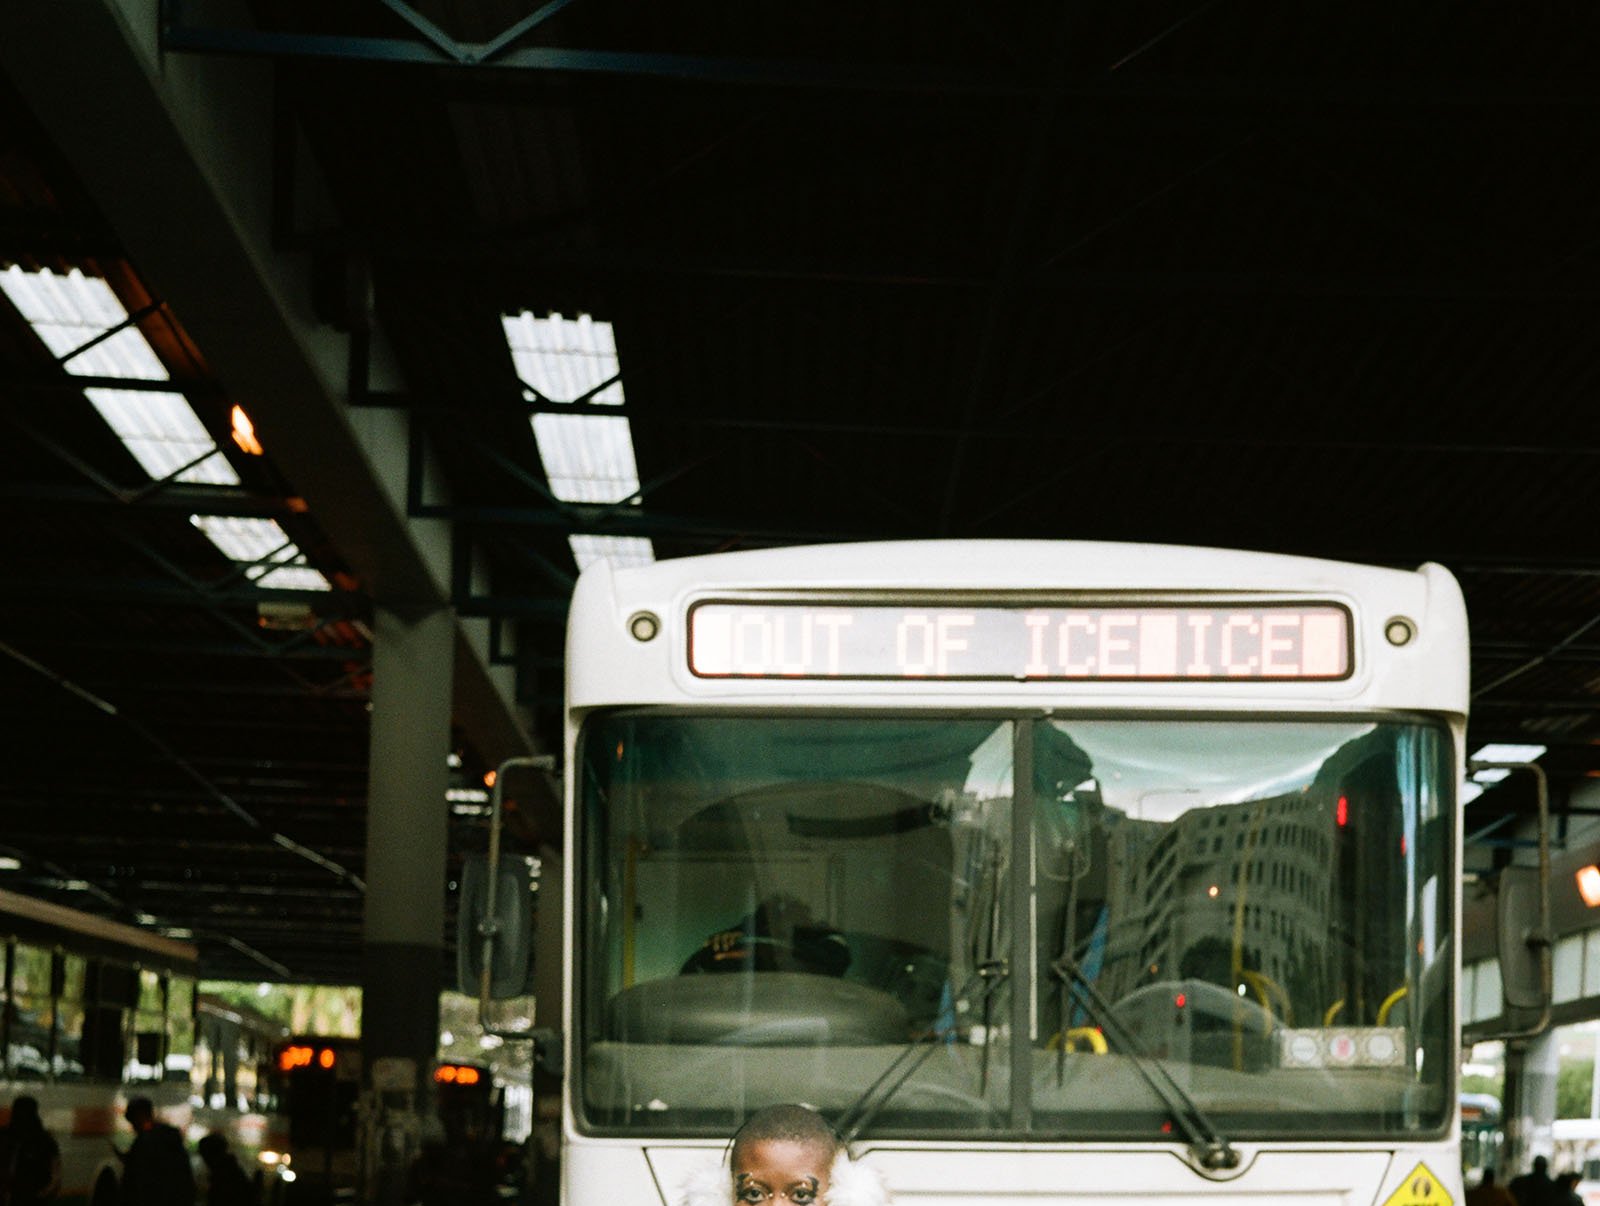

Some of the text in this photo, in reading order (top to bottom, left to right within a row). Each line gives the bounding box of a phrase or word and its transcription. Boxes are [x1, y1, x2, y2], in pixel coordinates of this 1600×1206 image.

[896, 615, 976, 676] OF
[1024, 614, 1138, 676] ICE
[1186, 614, 1301, 676] ICE
